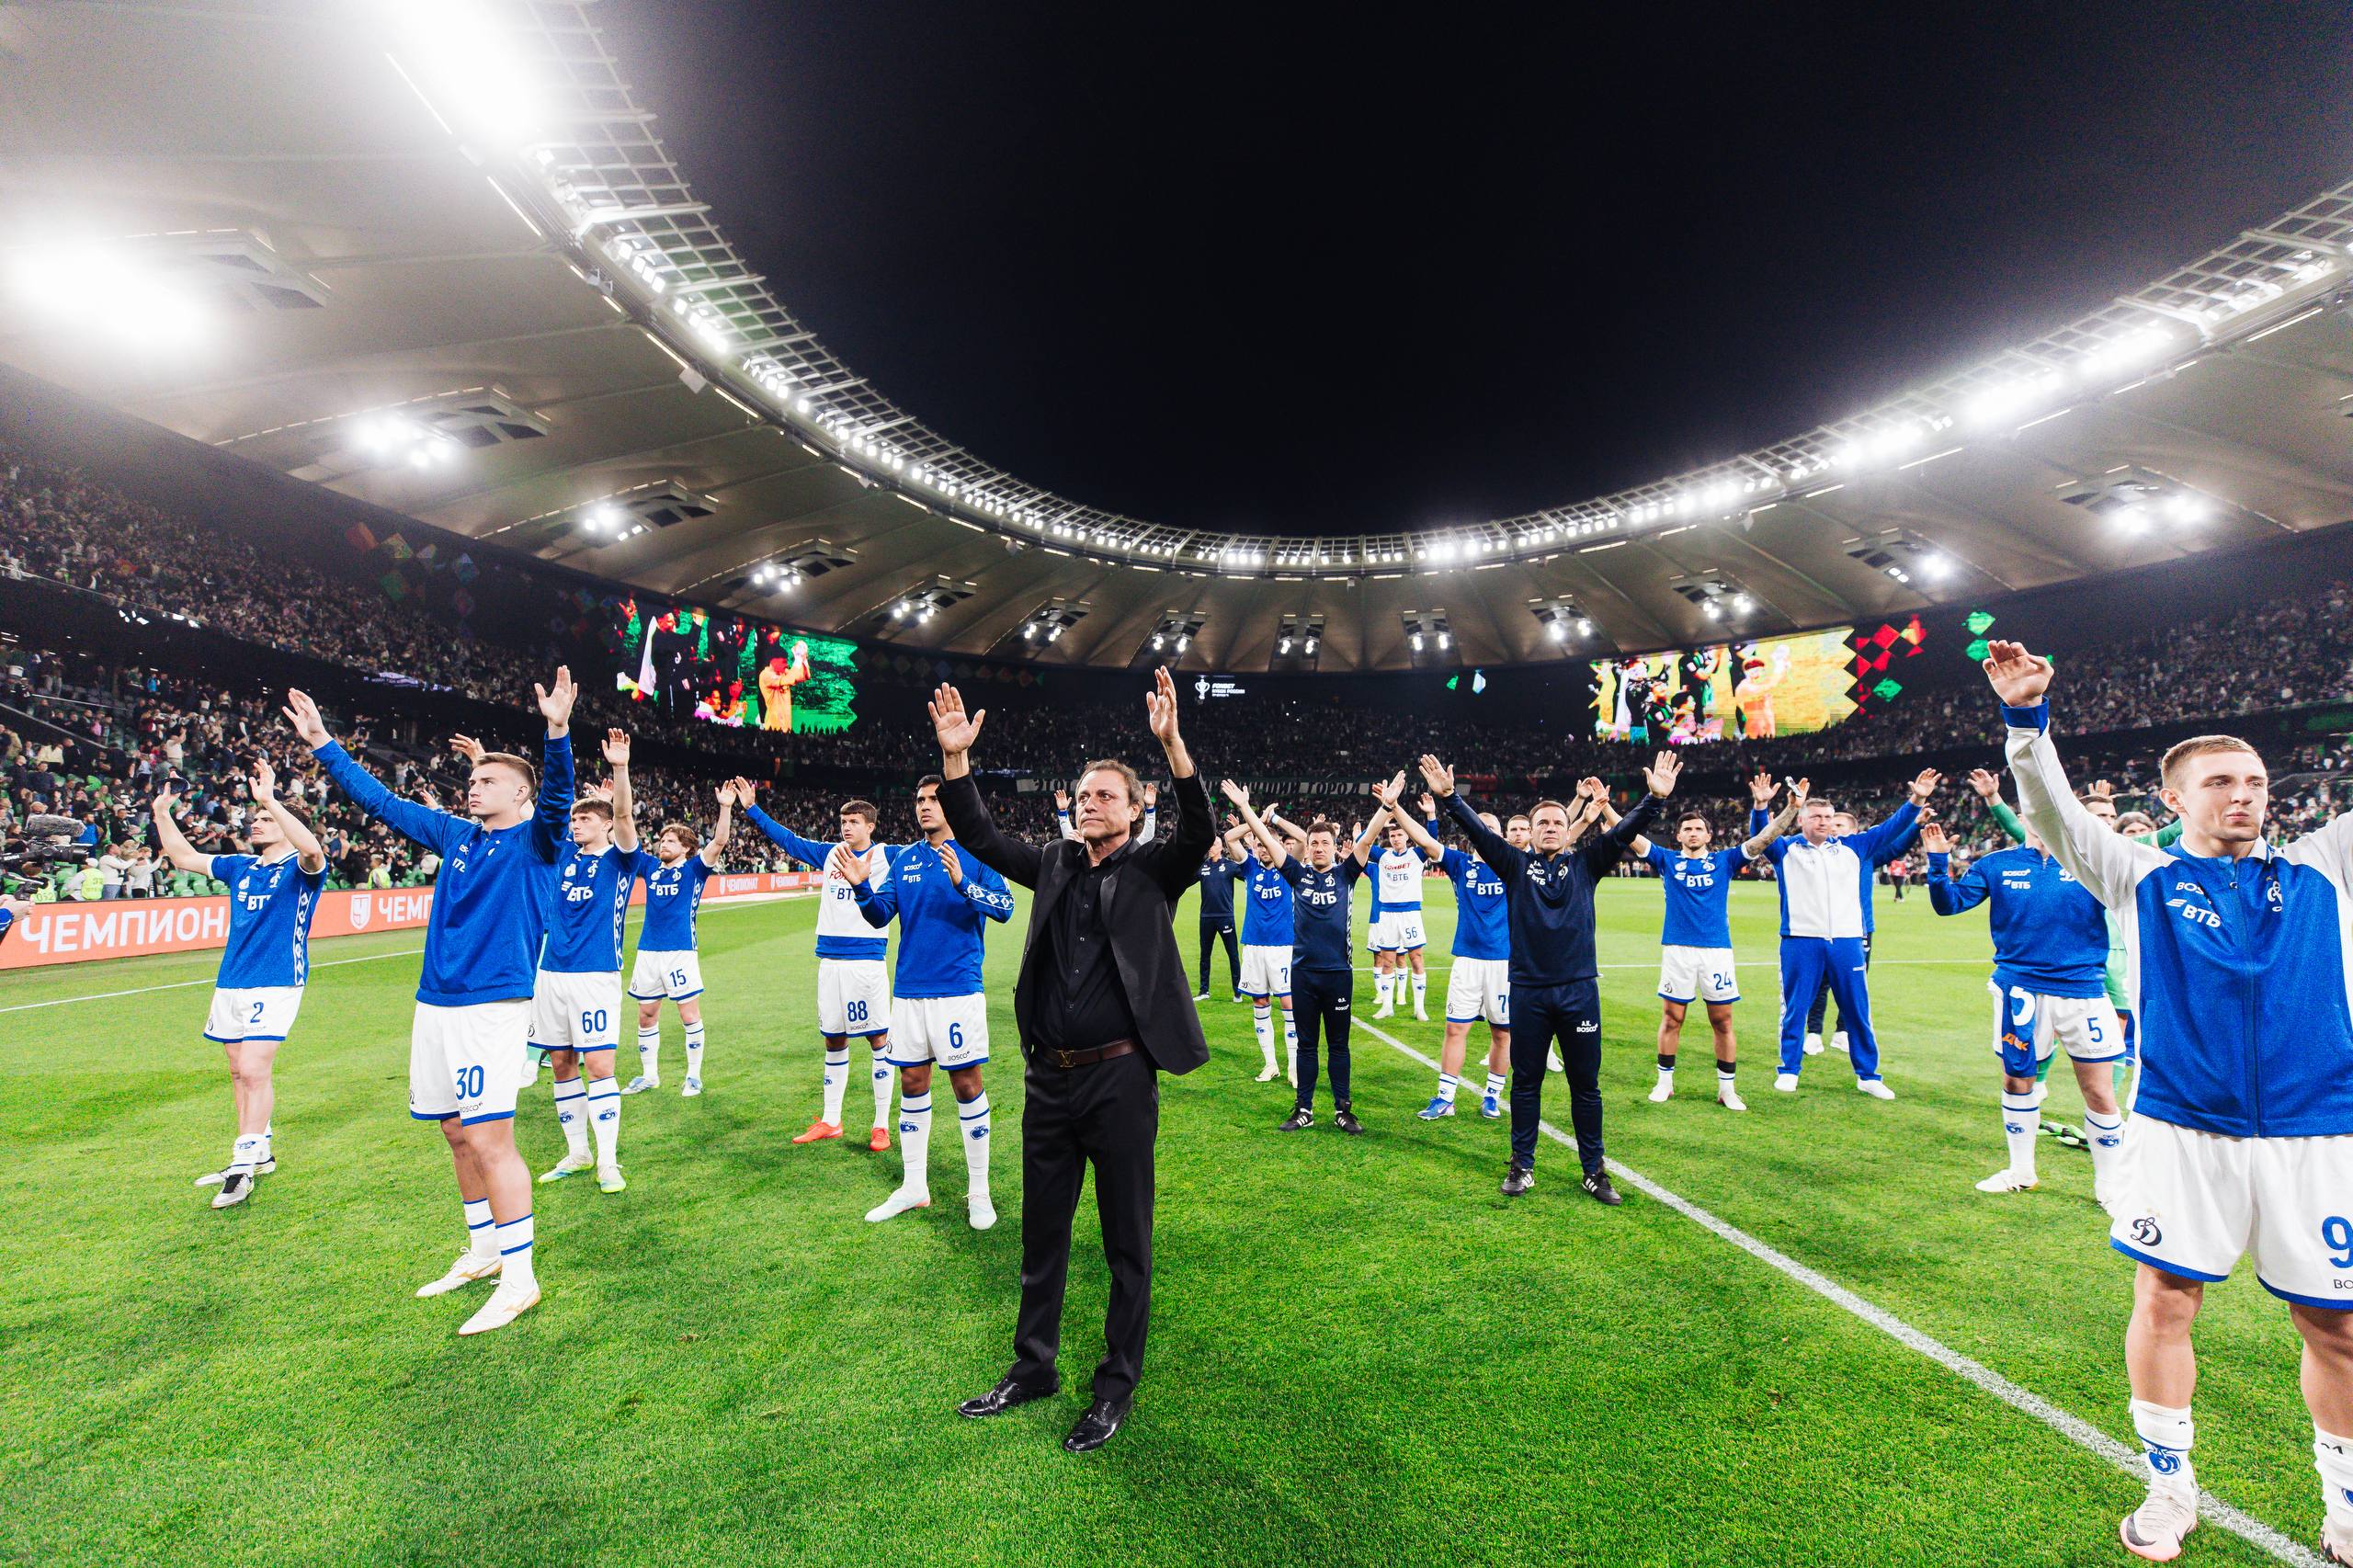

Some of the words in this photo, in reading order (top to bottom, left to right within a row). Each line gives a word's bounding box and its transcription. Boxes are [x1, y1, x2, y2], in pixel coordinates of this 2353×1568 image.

[656, 883, 679, 896] ВТБ
[1477, 882, 1504, 895] ВТБ
[1686, 873, 1714, 887] ВТБ
[566, 885, 594, 902] ВТБ
[837, 887, 853, 901] ВТ
[1261, 886, 1282, 899] ВТБ
[1312, 891, 1337, 905] ВТБ
[2181, 903, 2222, 928] ВТБ
[20, 905, 230, 954] ЧЕМПИОН
[1404, 926, 1418, 939] 56
[669, 969, 687, 988] 15
[1712, 971, 1733, 991] 24
[249, 1002, 265, 1024] 2
[847, 1000, 868, 1022] 88
[582, 1009, 608, 1034] 60
[2086, 1017, 2103, 1043] 5
[949, 1022, 963, 1050] 6
[948, 1051, 968, 1062] BOSCO
[456, 1064, 484, 1100] 30
[2322, 1215, 2353, 1268] 9
